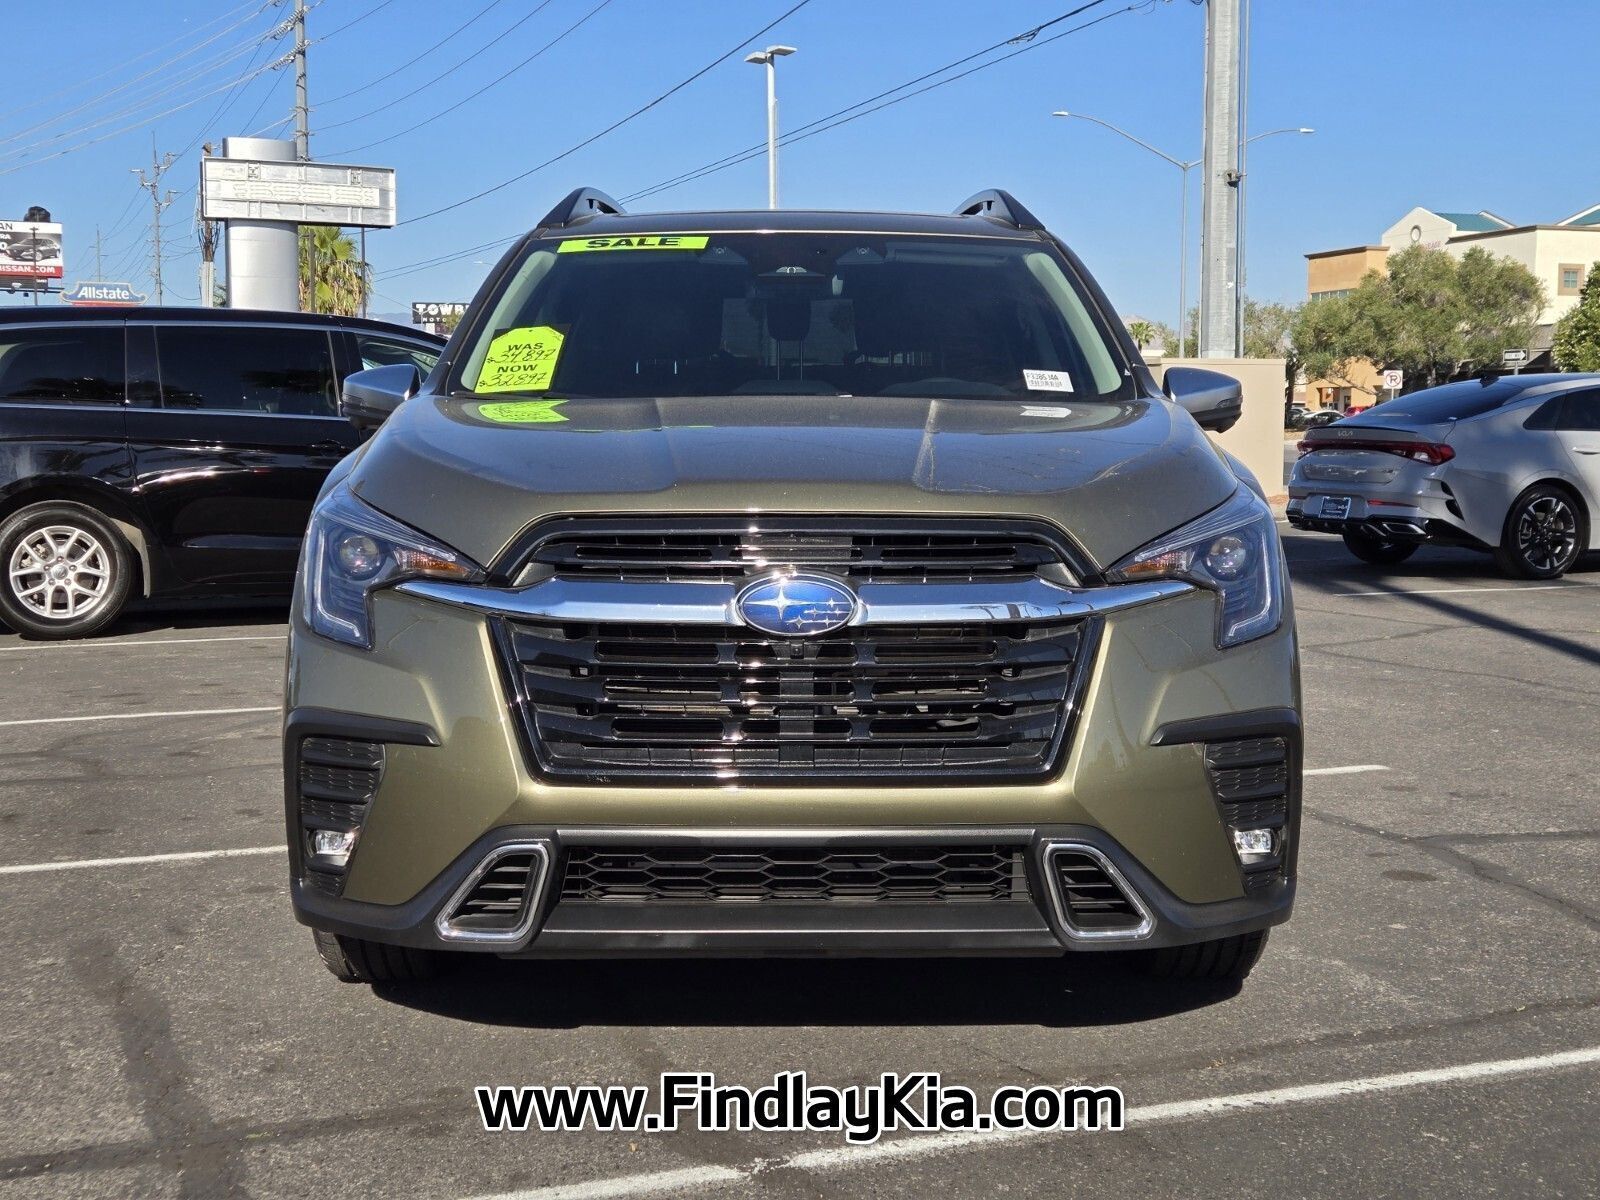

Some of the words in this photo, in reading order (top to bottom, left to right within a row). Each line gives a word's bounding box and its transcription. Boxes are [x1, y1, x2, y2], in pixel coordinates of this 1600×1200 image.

[586, 237, 681, 249] SALE
[77, 286, 130, 299] Allstate
[508, 342, 544, 352] WAS
[497, 364, 538, 373] NOW
